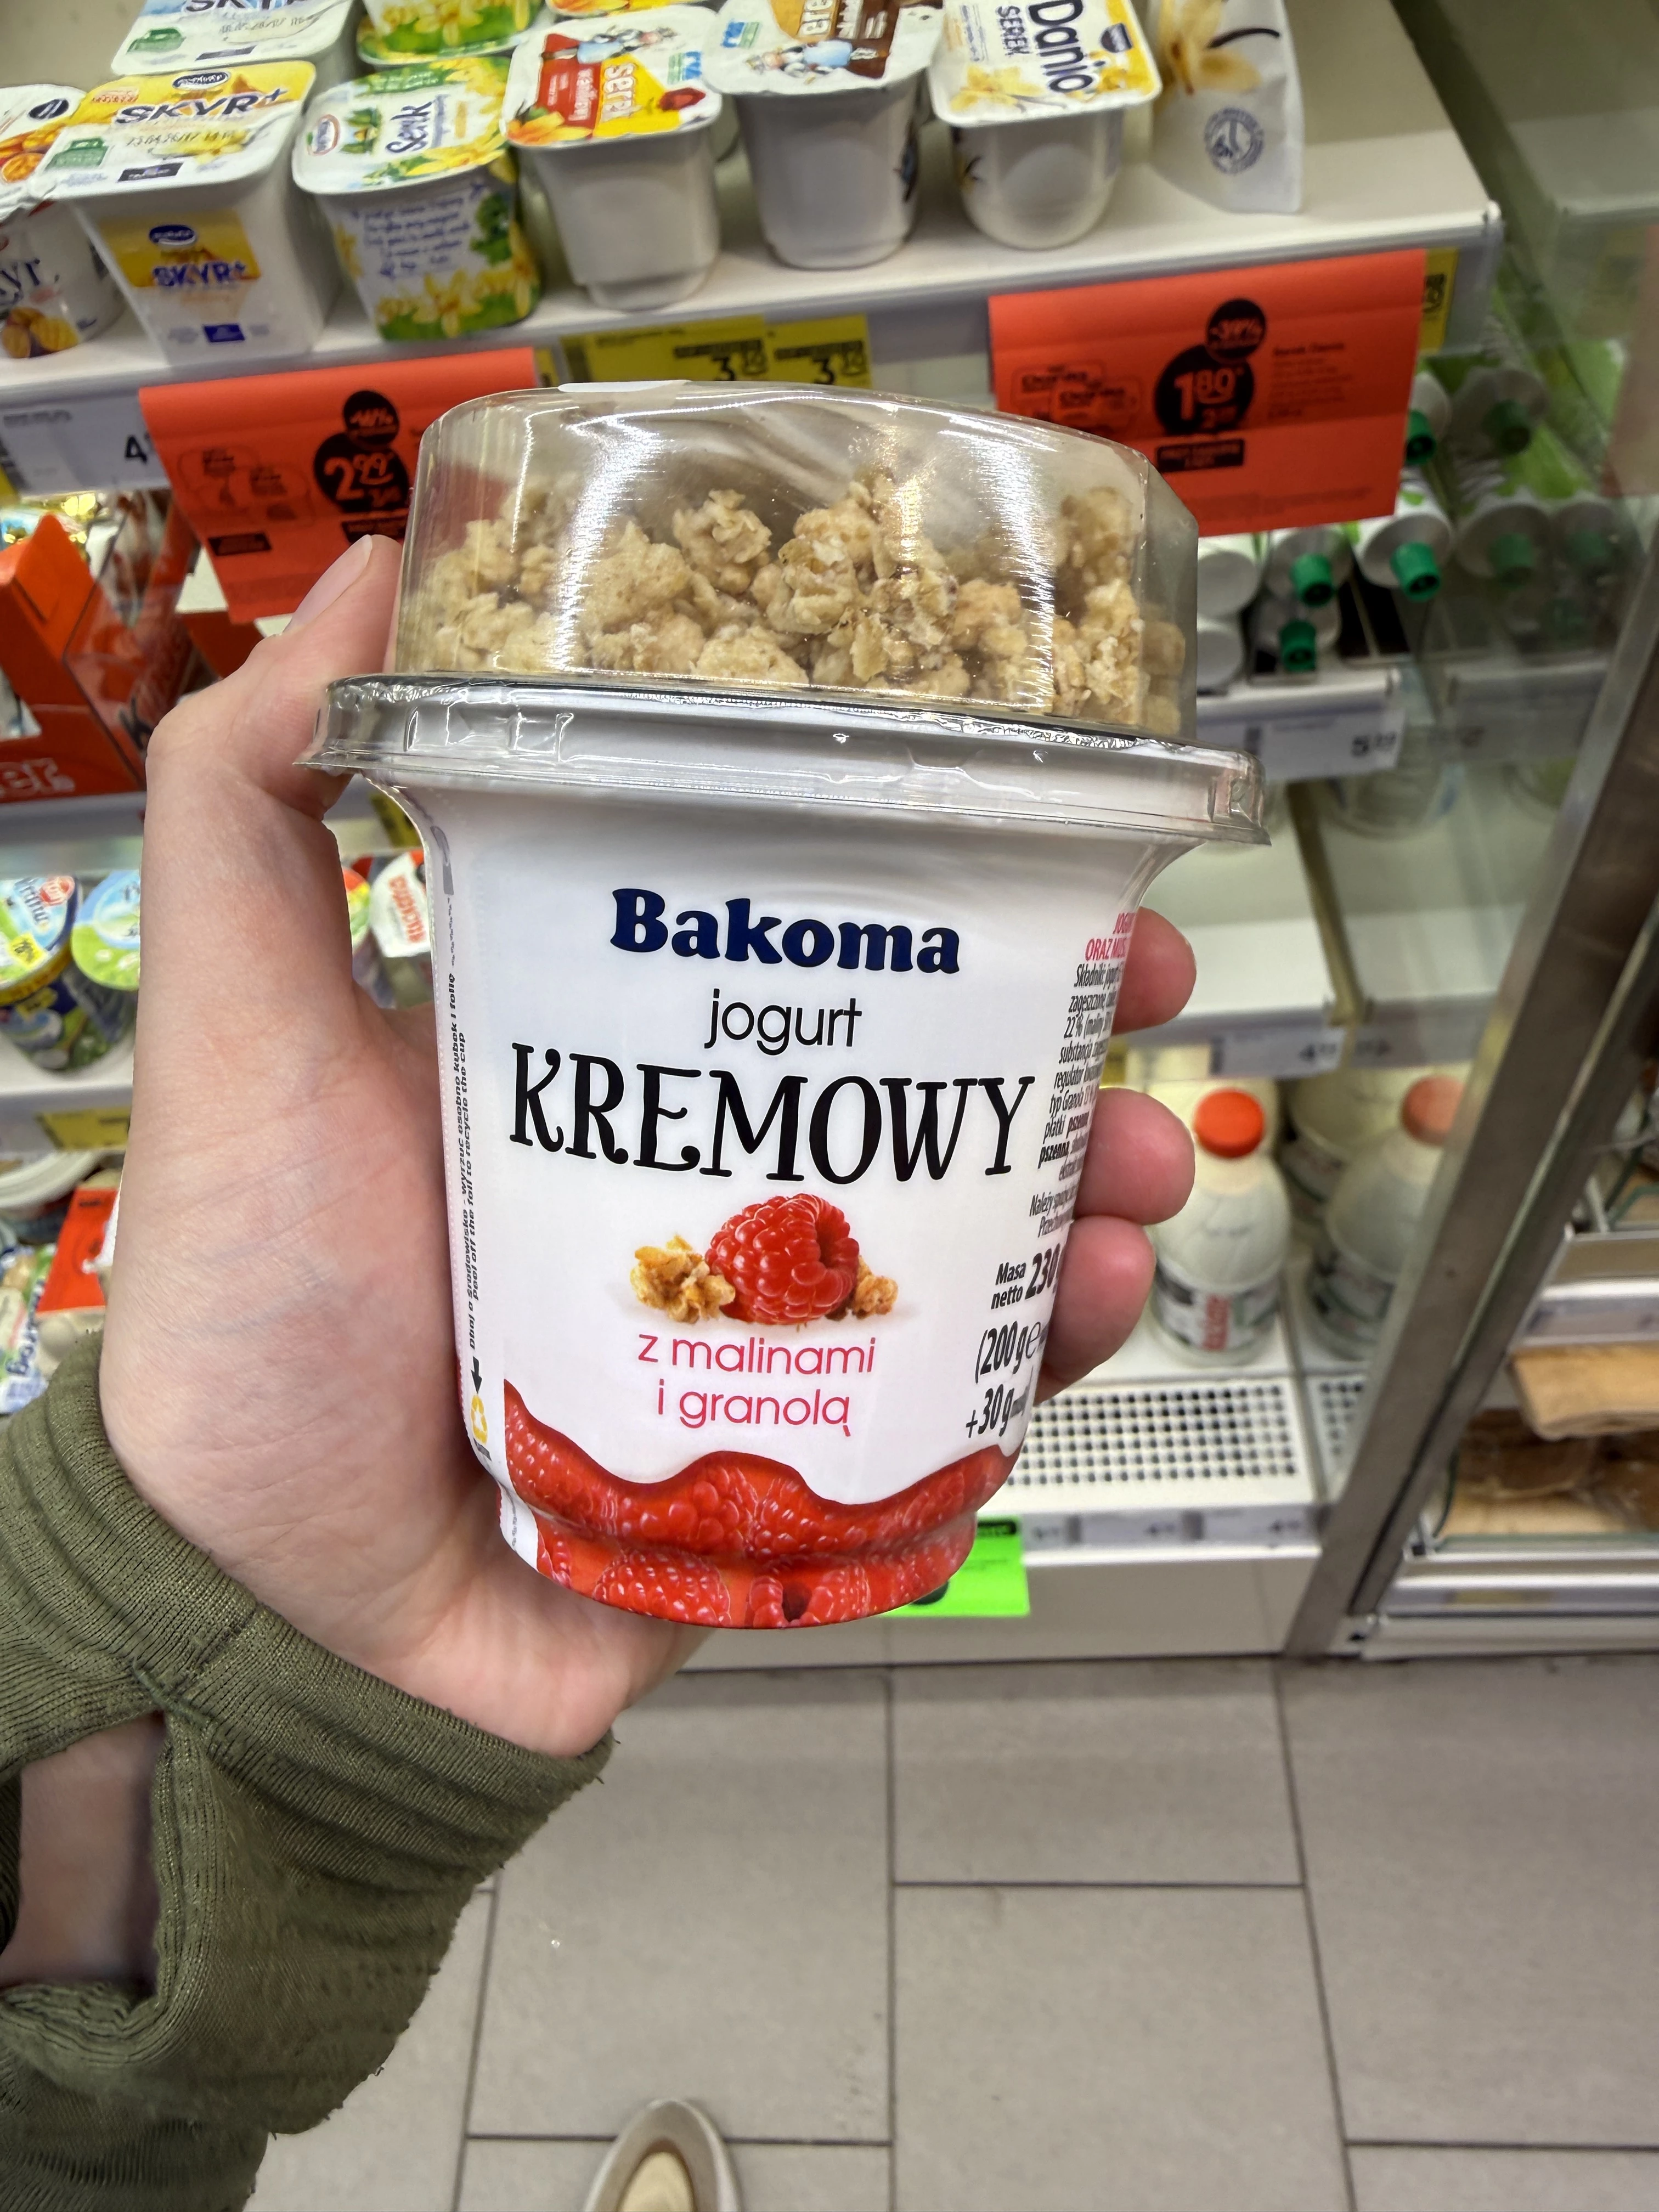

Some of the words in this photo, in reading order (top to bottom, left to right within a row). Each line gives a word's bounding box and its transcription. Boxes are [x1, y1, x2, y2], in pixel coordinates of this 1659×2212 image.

[1028, 0, 1105, 92] Danio
[114, 88, 289, 125] SKYR+
[610, 888, 960, 974] Bakoma
[1085, 938, 1113, 961] ORAZ
[452, 1022, 460, 1072] kubek
[704, 988, 862, 1056] jogurt
[510, 1042, 1035, 1184] KREMOWY
[1049, 1094, 1063, 1118] typ
[466, 1160, 472, 1177] to
[991, 1285, 1023, 1310] netto
[1025, 1243, 1060, 1300] 230
[995, 1262, 1026, 1286] Masa
[638, 1333, 658, 1363] z
[671, 1337, 876, 1375] malinami
[658, 1379, 664, 1415] i
[679, 1389, 851, 1437] granolą
